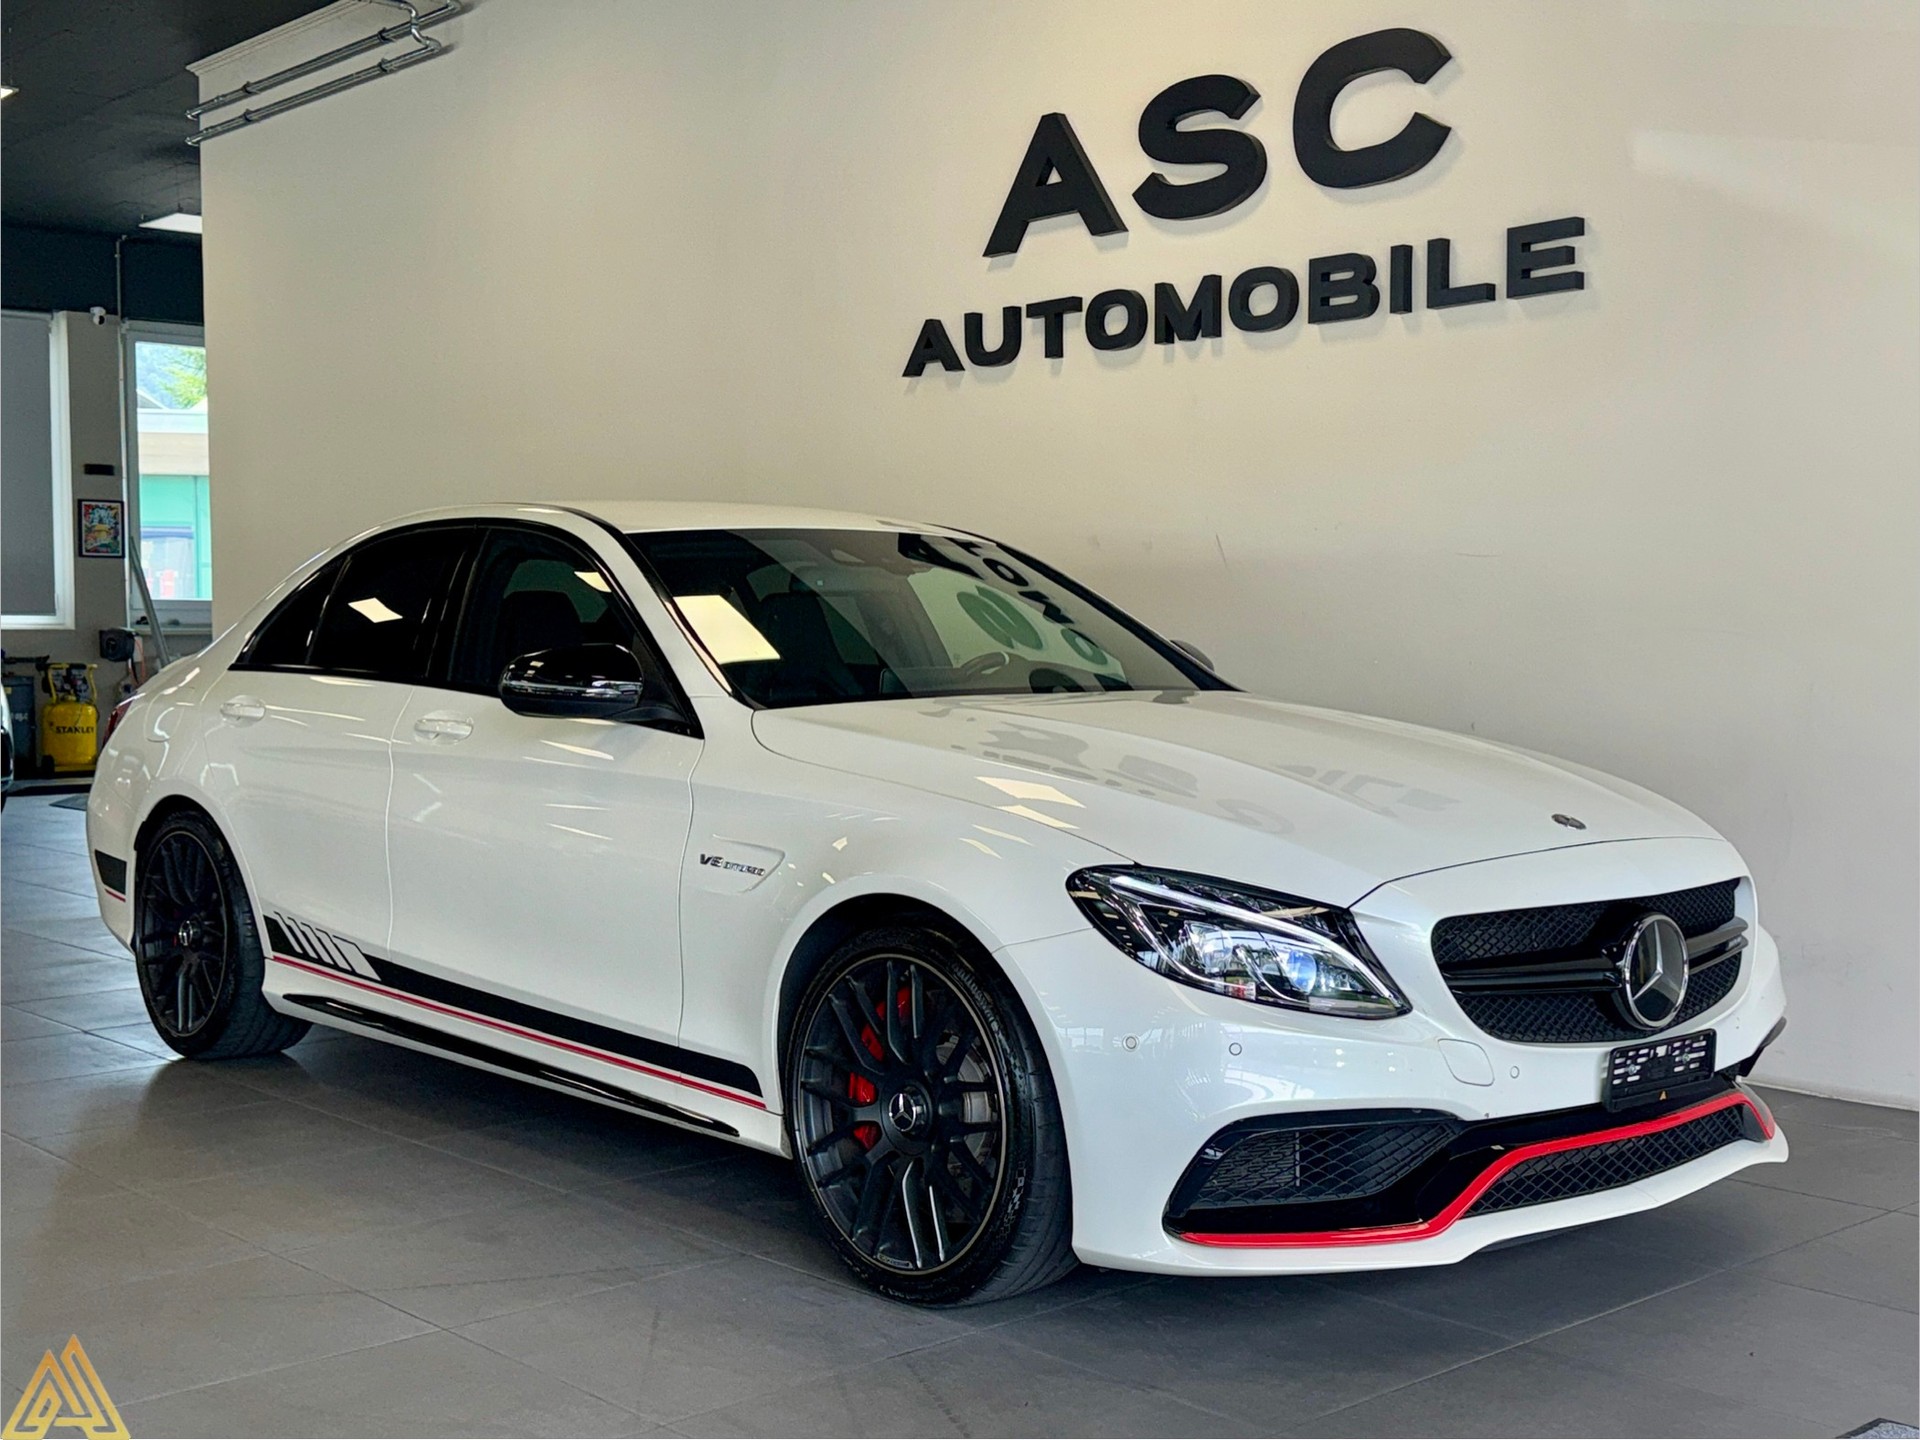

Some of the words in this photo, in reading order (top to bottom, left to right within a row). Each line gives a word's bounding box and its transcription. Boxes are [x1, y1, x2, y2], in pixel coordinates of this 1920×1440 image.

[983, 27, 1452, 257] ASC
[902, 217, 1585, 377] AUTOMOBILE
[55, 725, 95, 735] STANLEY
